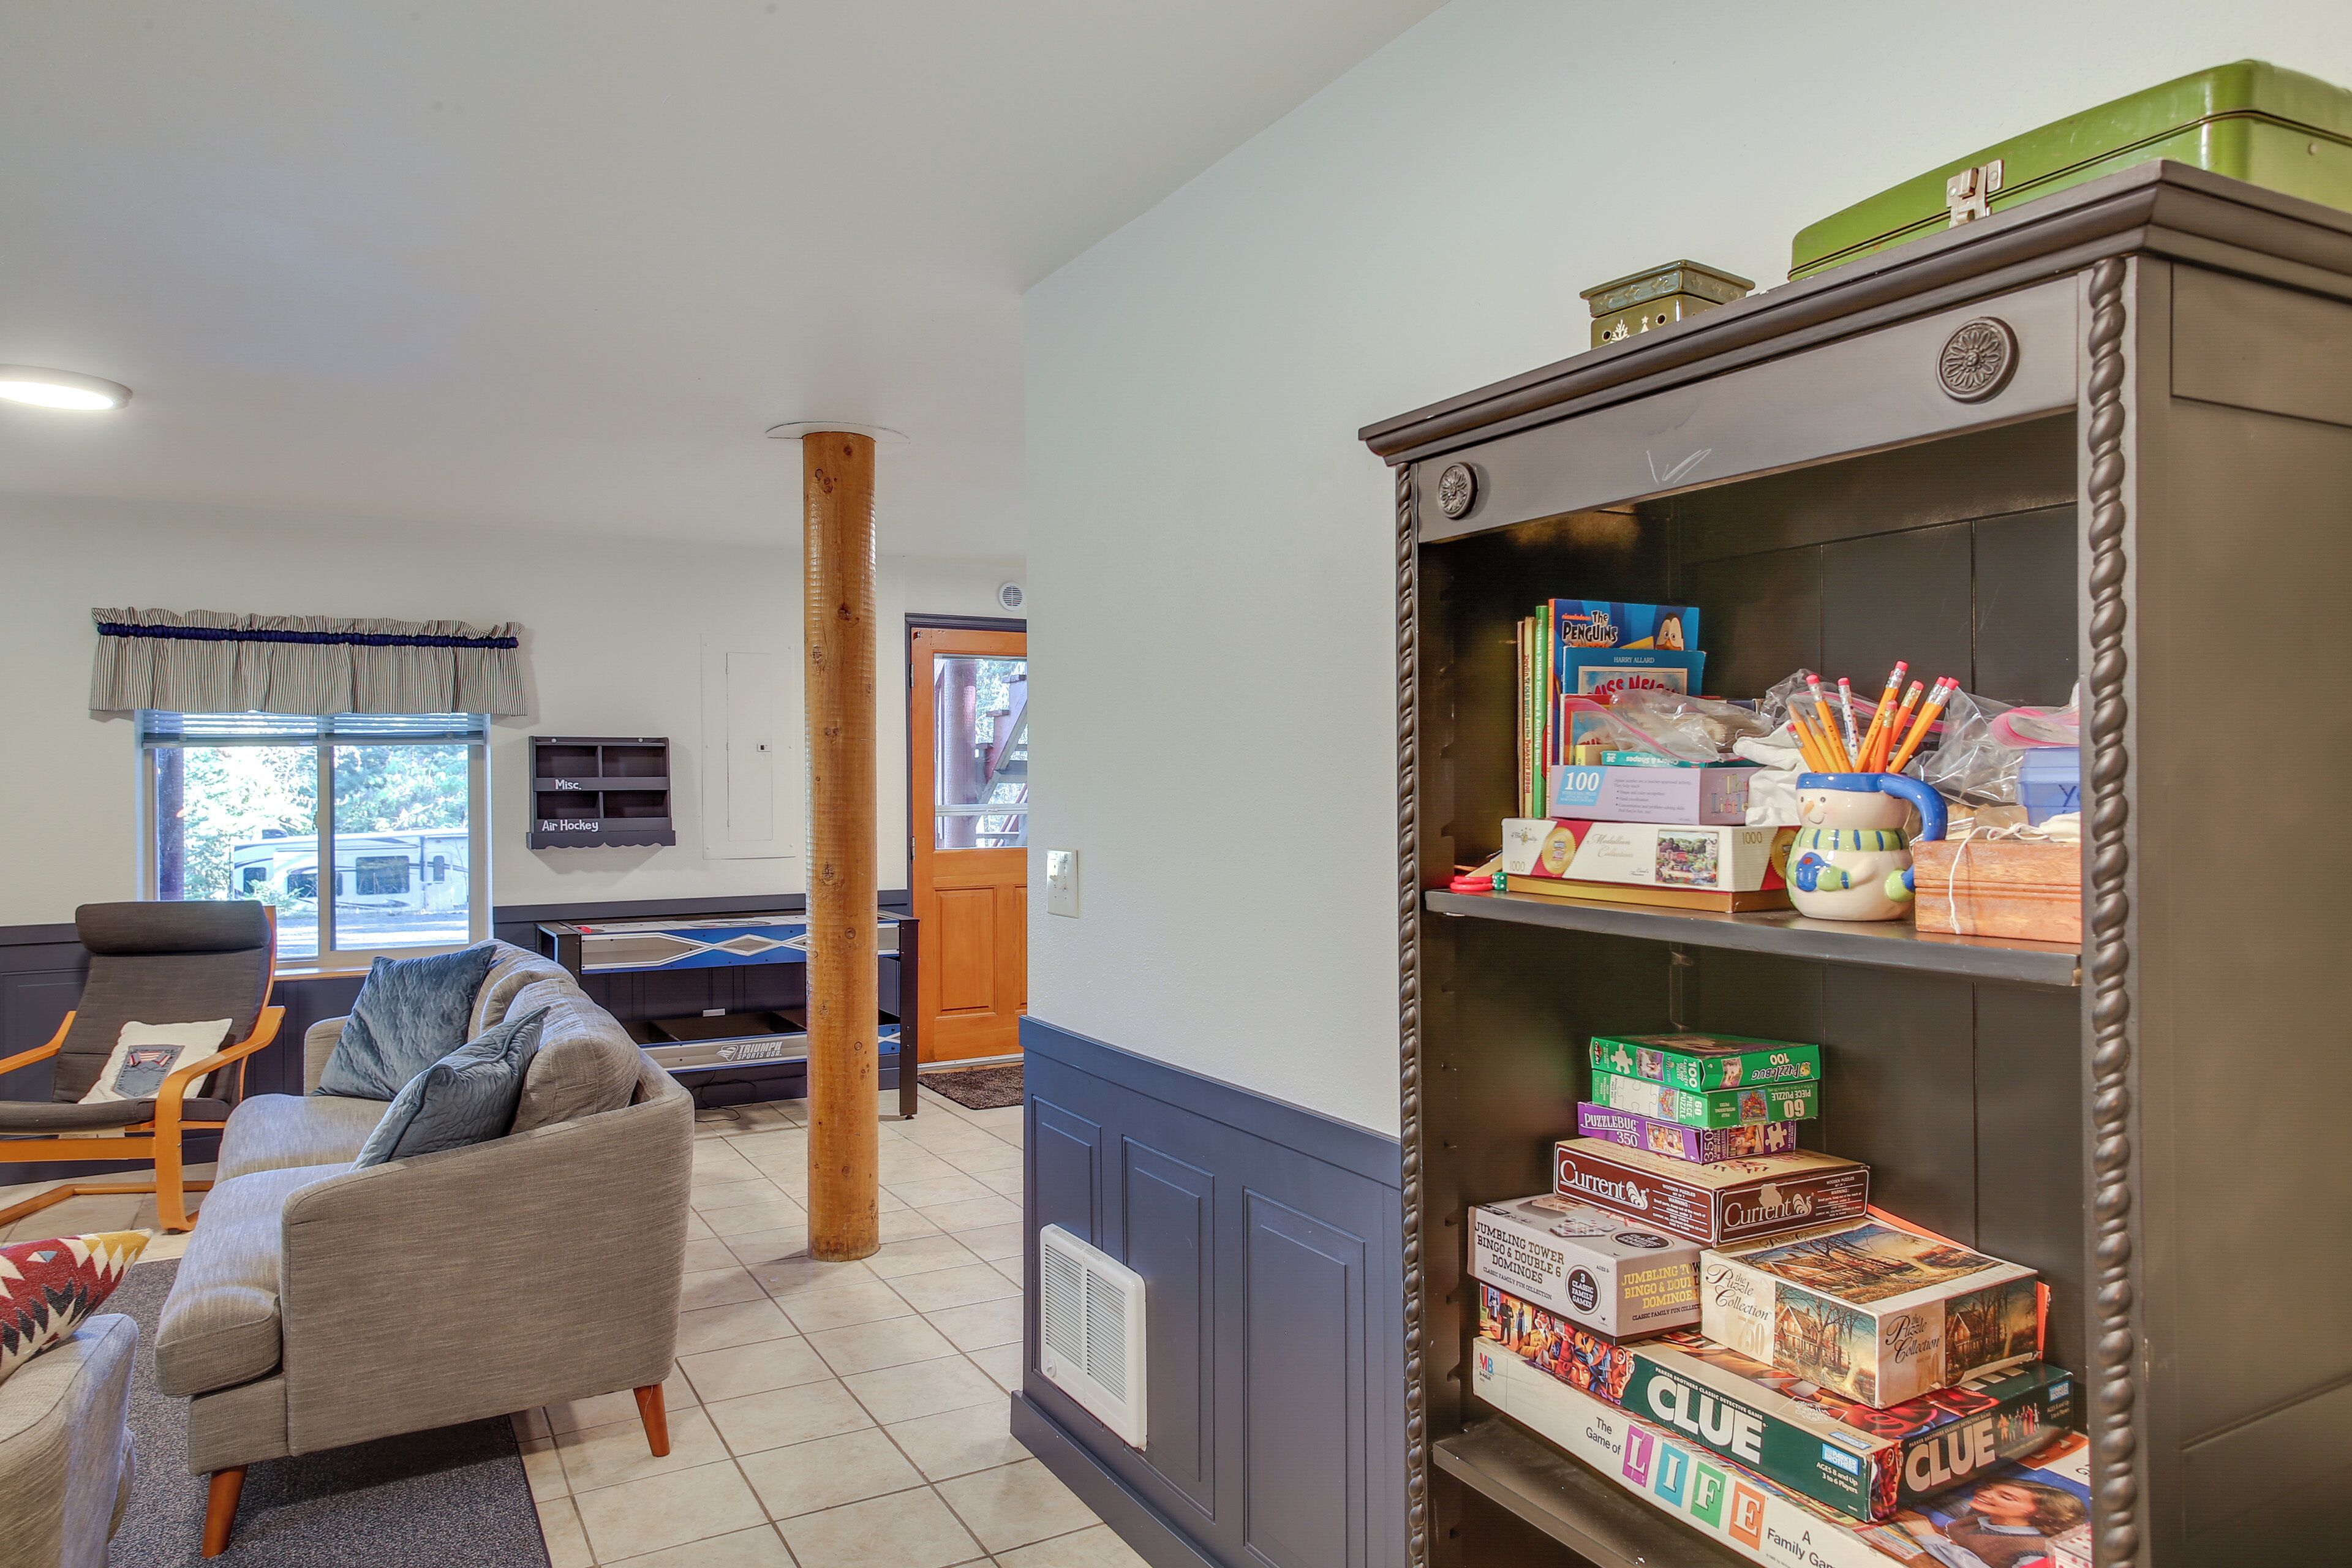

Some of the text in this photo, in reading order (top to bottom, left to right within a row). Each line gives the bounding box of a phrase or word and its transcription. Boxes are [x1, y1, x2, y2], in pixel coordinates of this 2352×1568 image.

[1591, 610, 1608, 623] The
[1562, 621, 1618, 642] PENGUINS
[1626, 755, 1650, 764] Shapes
[554, 778, 582, 791] Misc.
[1565, 772, 1600, 791] 100
[541, 820, 599, 832] Air Hockey
[1742, 831, 1763, 844] 1000
[1509, 860, 1526, 872] 1000
[737, 1052, 764, 1060] SPORTS
[739, 1041, 783, 1054] TRIUMPH
[1769, 1052, 1790, 1065] 100
[1687, 1060, 1698, 1088] 100
[1771, 1089, 1811, 1101] PIECE PUZZLE
[1694, 1100, 1703, 1116] 60
[1783, 1099, 1806, 1118] 60
[1583, 1113, 1637, 1132] PUZZLEBUG
[1616, 1130, 1638, 1148] 350
[1703, 1130, 1714, 1162] 350
[1559, 1159, 1626, 1200] Current
[1662, 1183, 1696, 1198] WOODEN PUZZLES
[1724, 1198, 1792, 1227] Current
[1474, 1221, 1564, 1265] JUMBLING TOWER
[1476, 1234, 1561, 1278] BINGO & DOUBLE 6
[1491, 1253, 1544, 1284] DOMINOES
[1580, 1272, 1586, 1282] 3
[1621, 1265, 1678, 1286] JUMBLING
[1483, 1266, 1553, 1300] CLASSIC FAMILY FUN COLLECTION
[1571, 1280, 1594, 1293] CLASSIC
[1706, 1264, 1754, 1297] Puzzle
[1735, 1273, 1747, 1284] the
[1571, 1287, 1594, 1301] FAMILY
[1624, 1281, 1657, 1300] BINGO
[1659, 1281, 1666, 1292] &
[1571, 1294, 1593, 1309] GAMES
[1714, 1284, 1769, 1321] Collection
[1632, 1312, 1651, 1321] CLASSIC
[1651, 1310, 1670, 1318] FAMILY
[1737, 1315, 1766, 1357] 750
[1885, 1314, 1928, 1346] Puzzle
[1894, 1336, 1940, 1364] Collection
[1479, 1352, 1493, 1374] MB
[1655, 1366, 1763, 1421] PARKER BROTHERS CLASSIC DETECTIVE GAME
[1596, 1416, 1613, 1435] The
[1646, 1374, 1763, 1465] CLUE
[1585, 1427, 1621, 1456] Game of
[1824, 1453, 1858, 1472] BROTHERS
[1833, 1447, 1858, 1468] PARKER
[1905, 1417, 1996, 1493] CLUE
[1816, 1461, 1831, 1474] AGES
[1838, 1471, 1849, 1481] and
[1849, 1475, 1858, 1487] Up
[1626, 1433, 1761, 1538] LIFE
[1838, 1479, 1858, 1494] Players
[1766, 1527, 1806, 1561] Family
[1801, 1529, 1811, 1545] A
